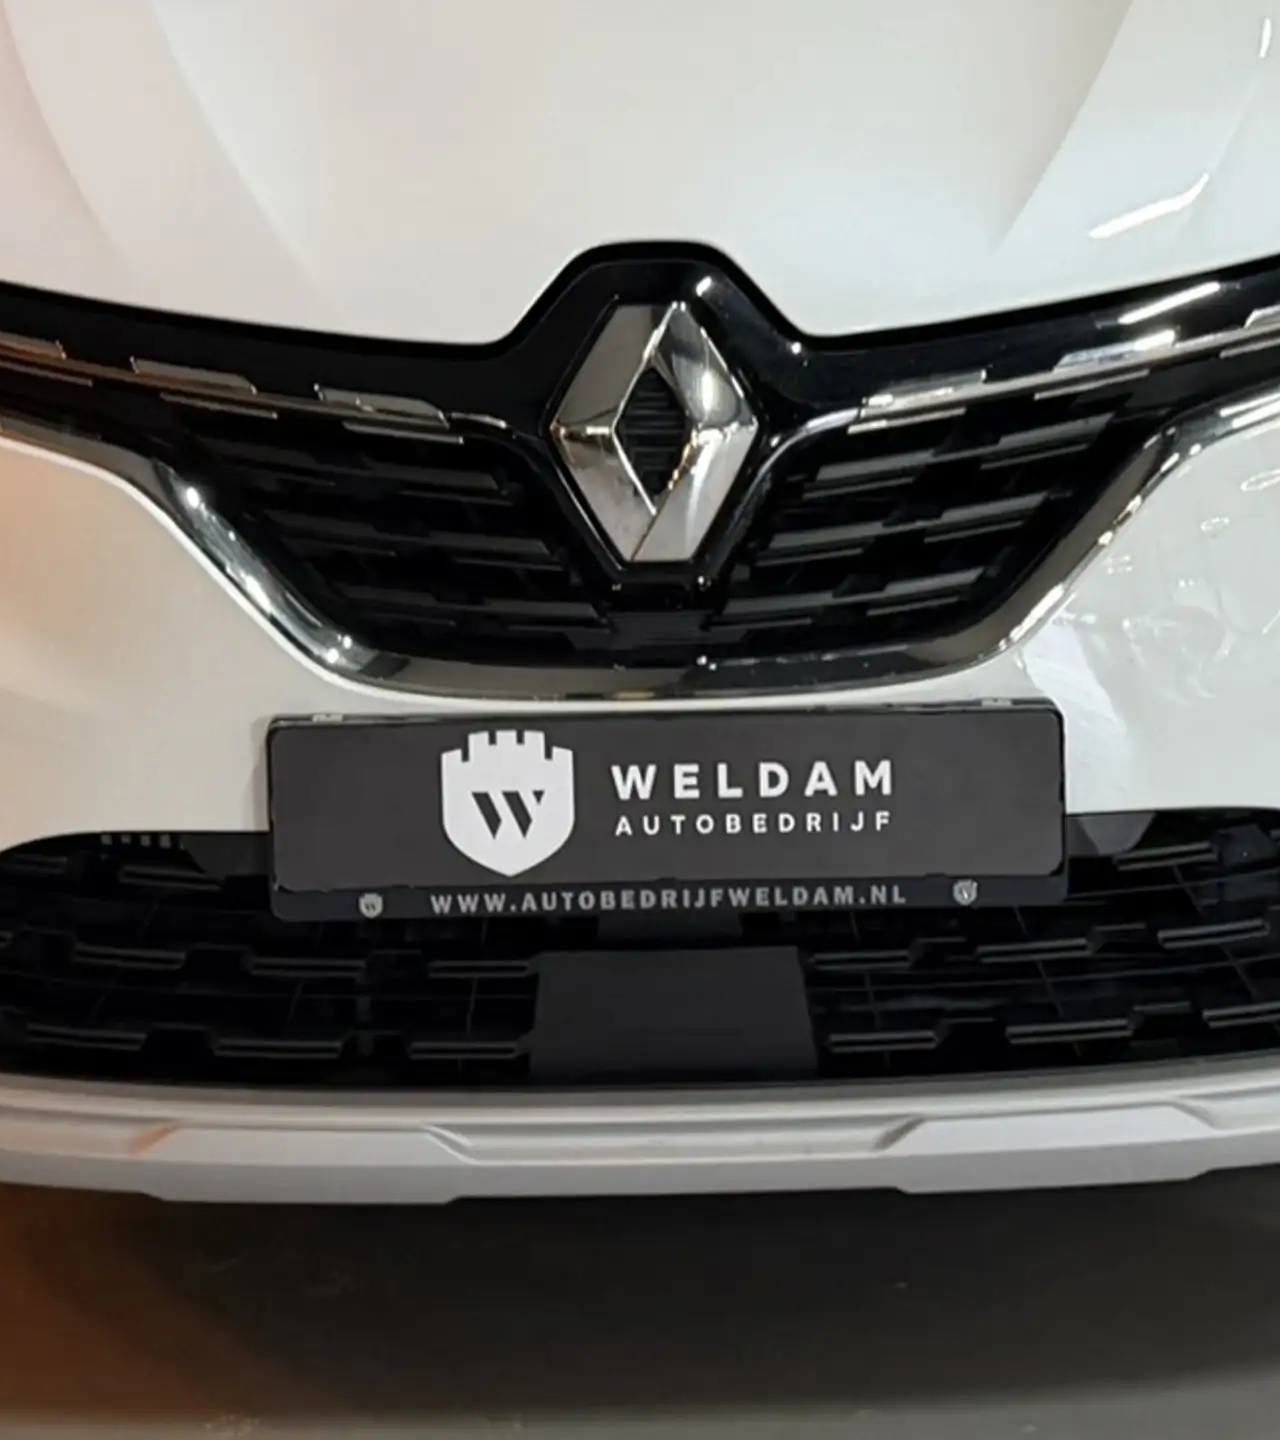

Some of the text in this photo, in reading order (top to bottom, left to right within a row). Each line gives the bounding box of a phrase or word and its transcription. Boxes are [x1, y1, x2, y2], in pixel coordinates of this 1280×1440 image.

[610, 759, 892, 801] WELDAM
[615, 810, 890, 836] AUTOBEDRIJF
[430, 885, 907, 914] WWW.AUTOBEDRIJFWELDAM.NL
